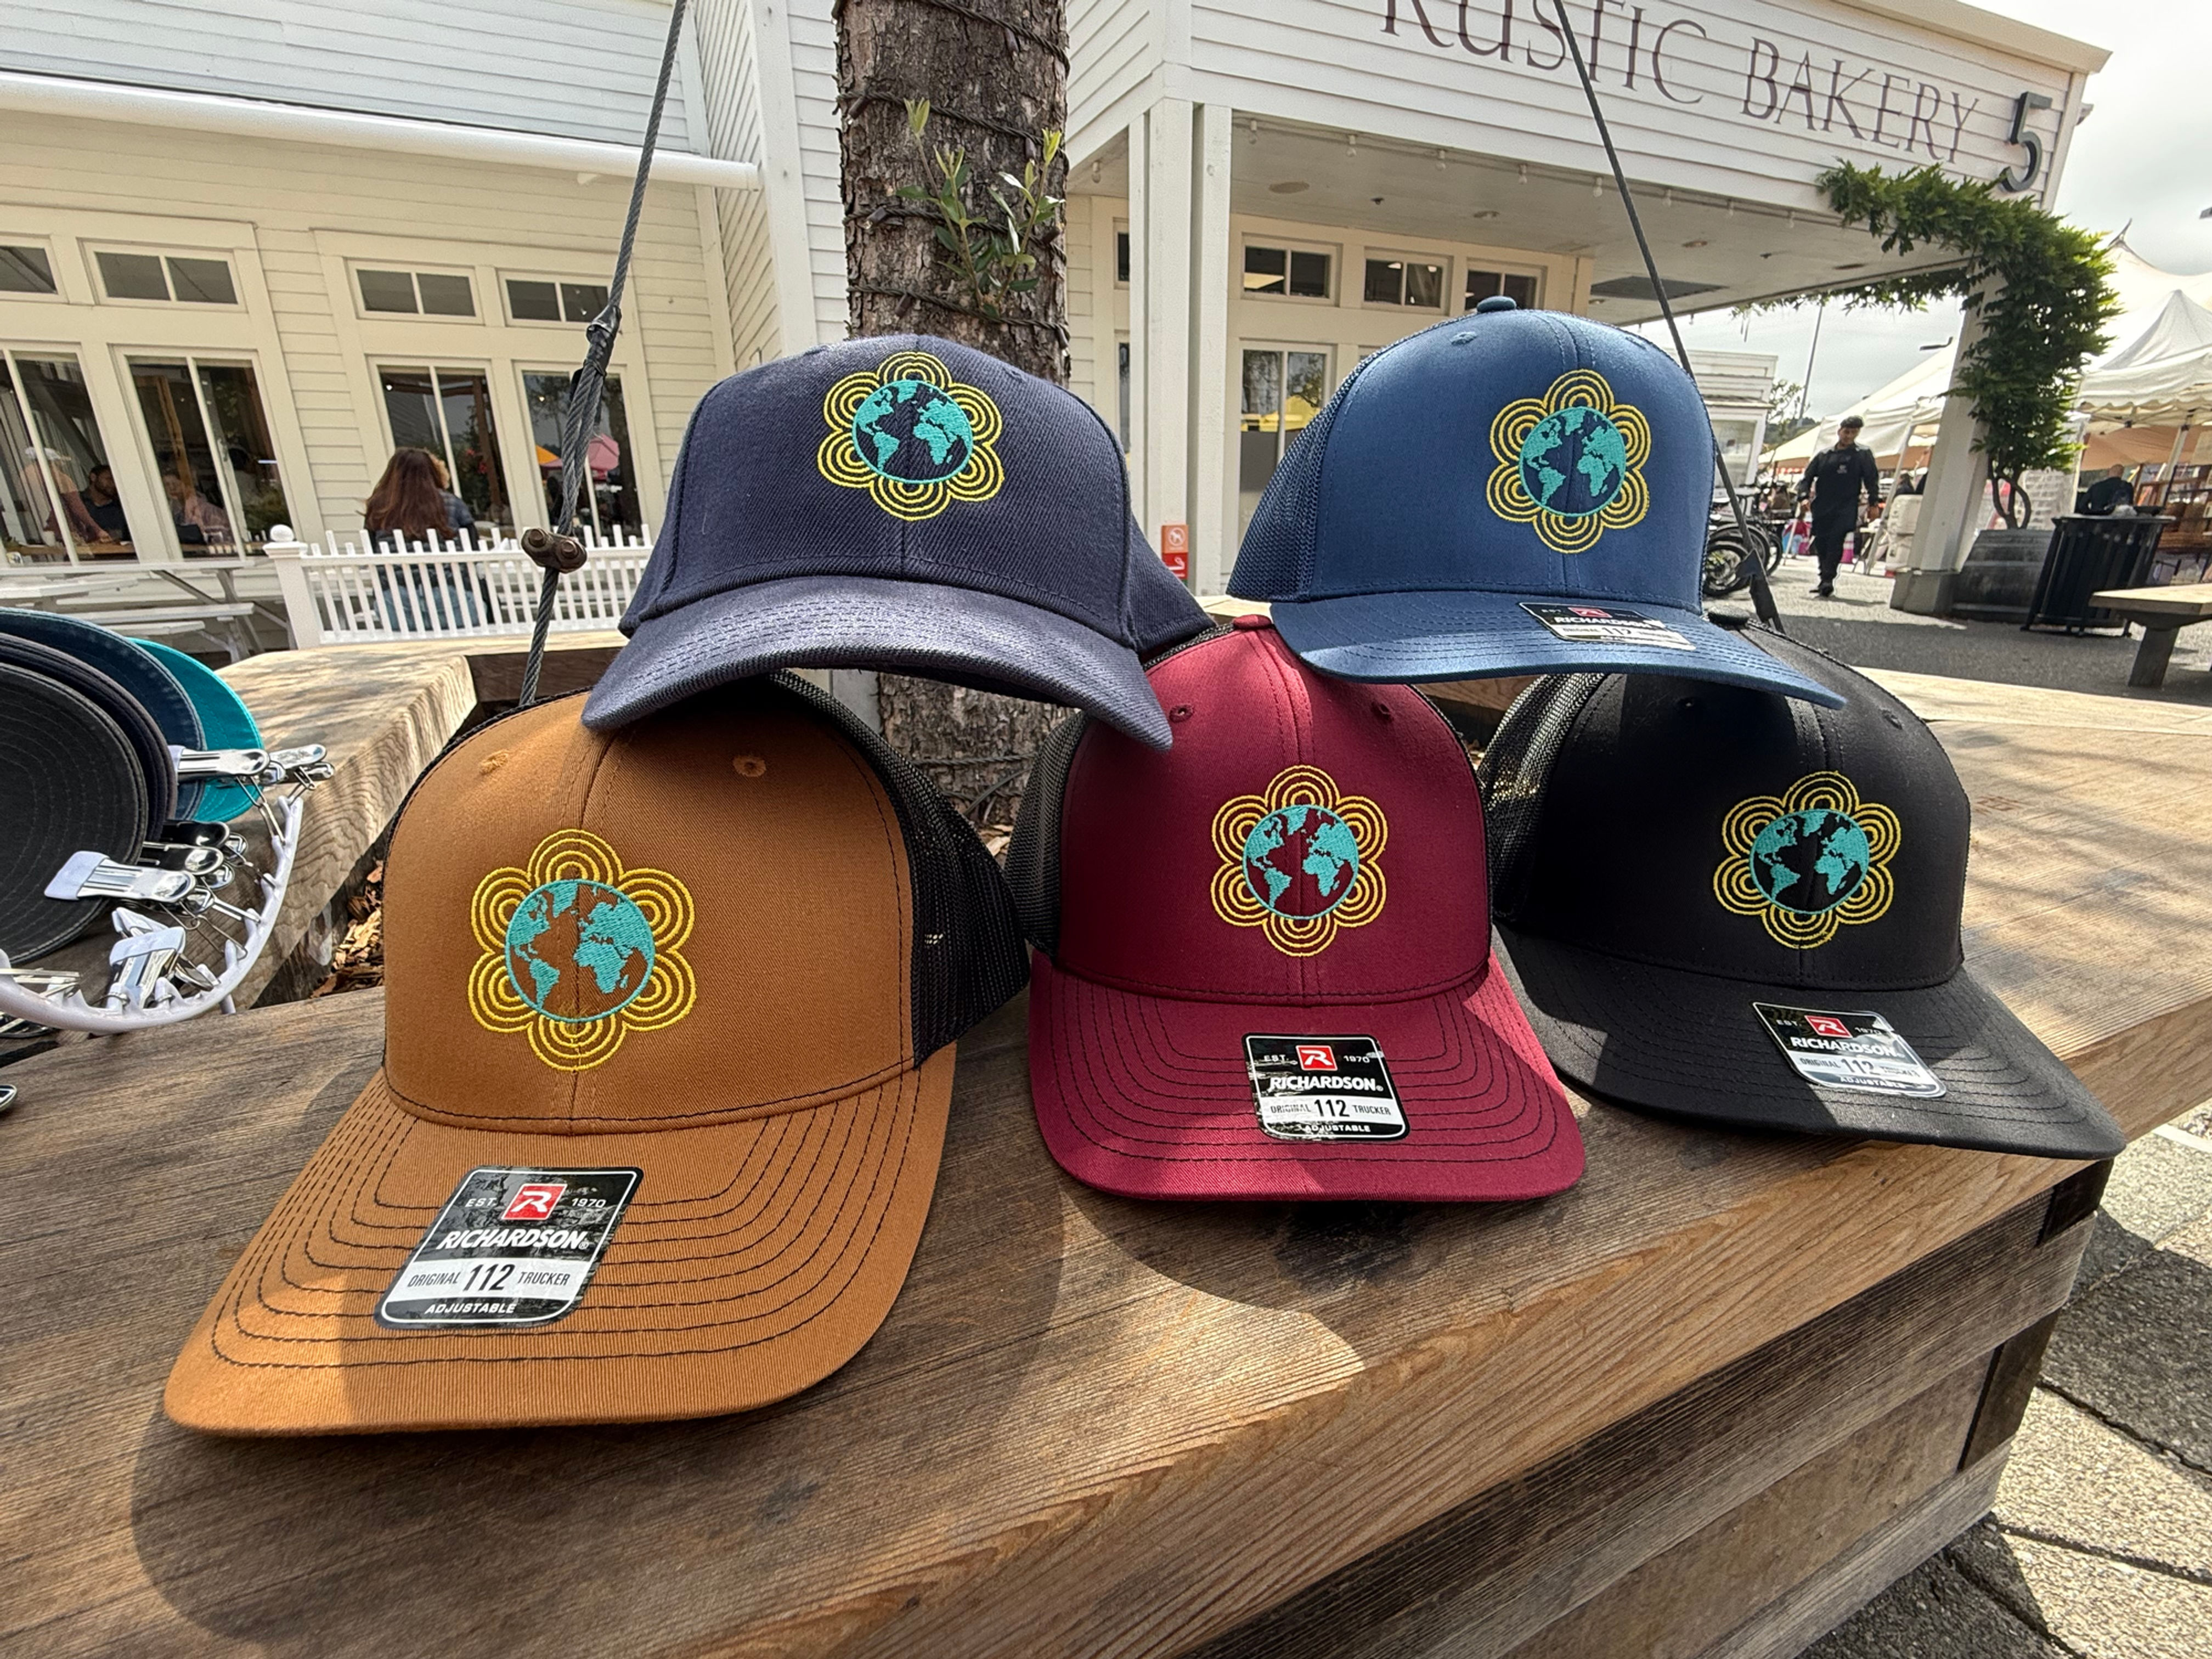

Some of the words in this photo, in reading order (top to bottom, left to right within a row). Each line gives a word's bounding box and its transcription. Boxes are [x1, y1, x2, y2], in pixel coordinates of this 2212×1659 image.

[1740, 37, 1979, 164] BAKERY
[1999, 91, 2052, 193] 5
[1301, 1049, 1333, 1066] R
[1344, 1055, 1370, 1063] 1970
[1841, 1058, 1881, 1075] 112
[1314, 1099, 1350, 1117] 112
[1352, 1104, 1391, 1115] TRUCKER
[1304, 1124, 1371, 1132] ADJUSTABLE
[510, 1190, 552, 1213] R
[571, 1197, 607, 1208] 1970
[407, 1271, 461, 1288] ORIGINAL
[462, 1263, 516, 1291] 112
[517, 1271, 571, 1286] TRUCKER
[425, 1303, 517, 1314] ADJUSTABLE
